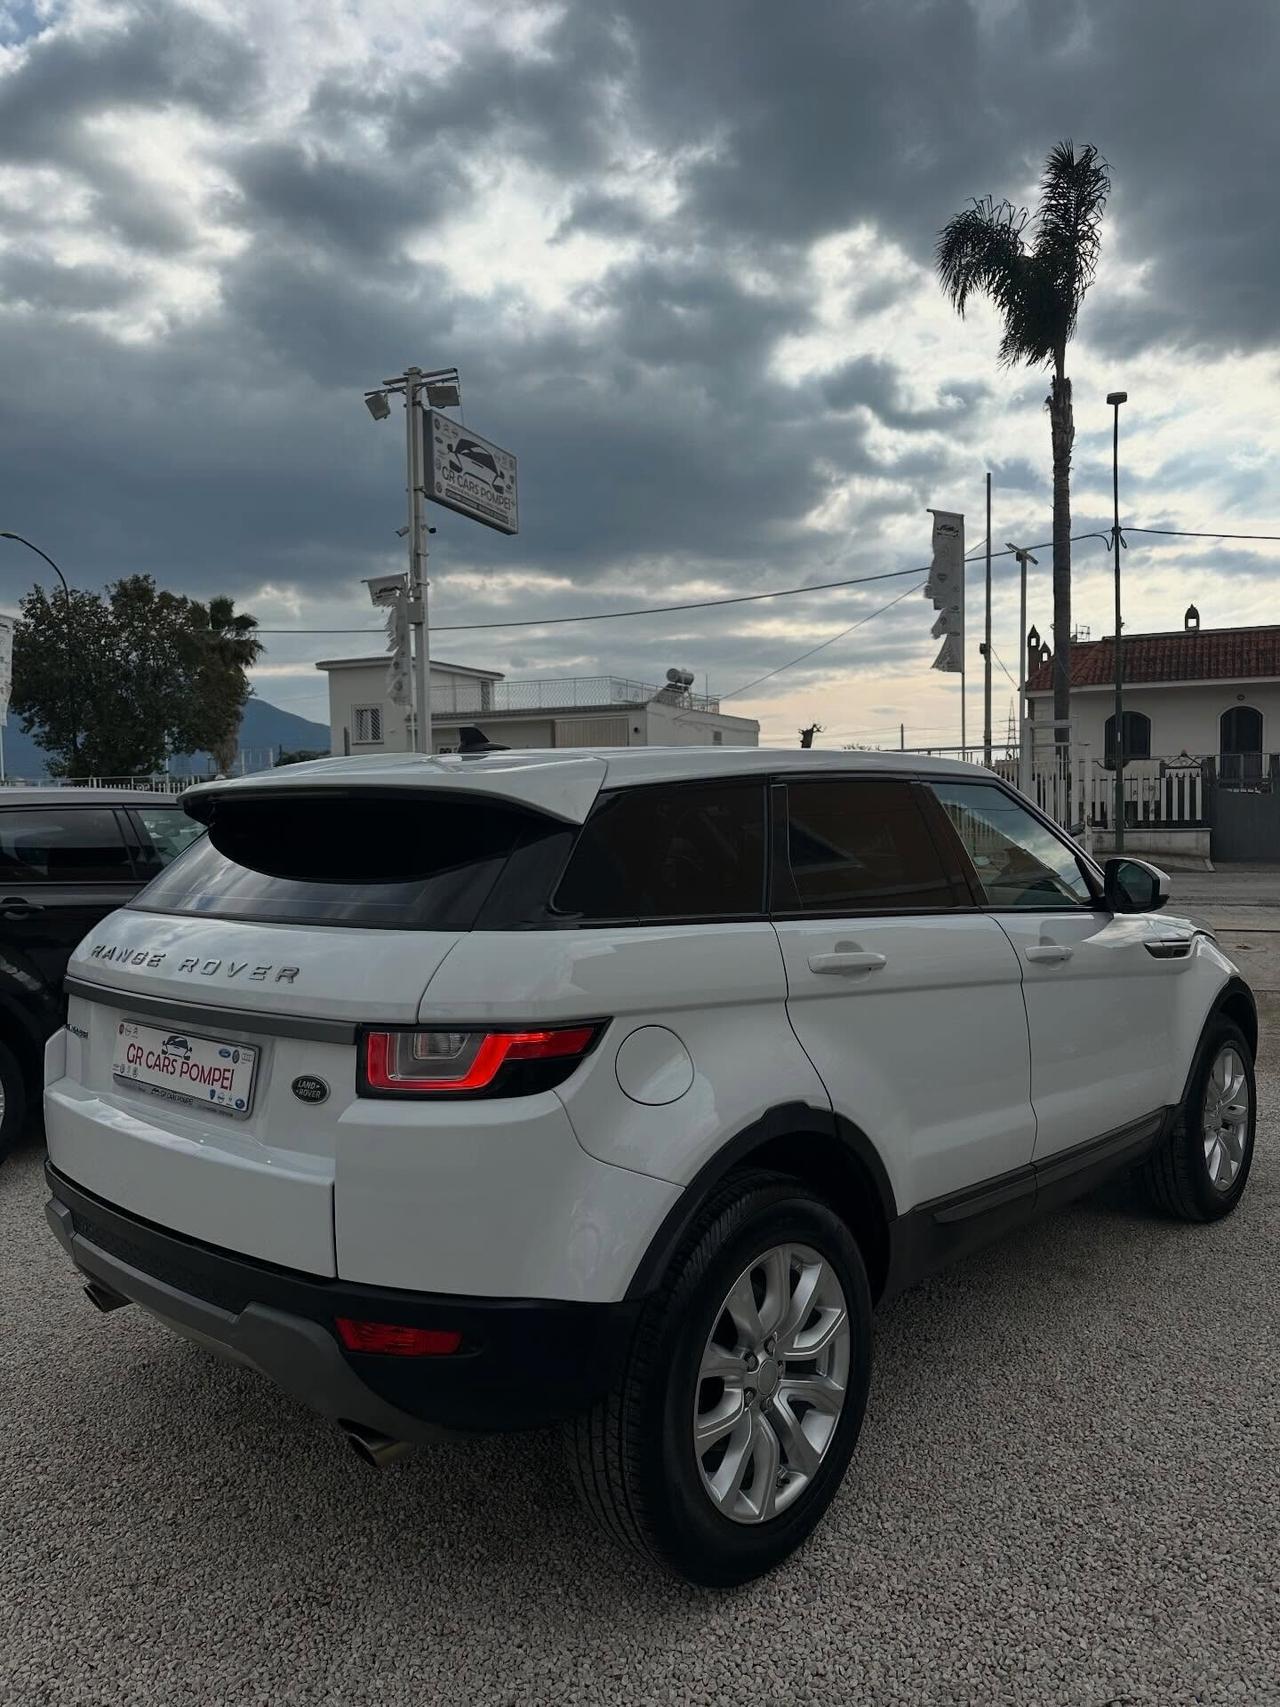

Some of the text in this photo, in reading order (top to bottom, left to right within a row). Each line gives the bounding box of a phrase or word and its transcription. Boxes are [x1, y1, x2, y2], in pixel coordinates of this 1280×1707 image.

[442, 466, 455, 484] GR
[457, 475, 479, 496] CARS
[480, 487, 511, 511] POMPEI
[91, 945, 300, 984] RANGE ROVER
[126, 1043, 235, 1092] GR CARS POMPEI
[297, 1080, 316, 1090] LAND
[298, 1089, 321, 1099] ROVER
